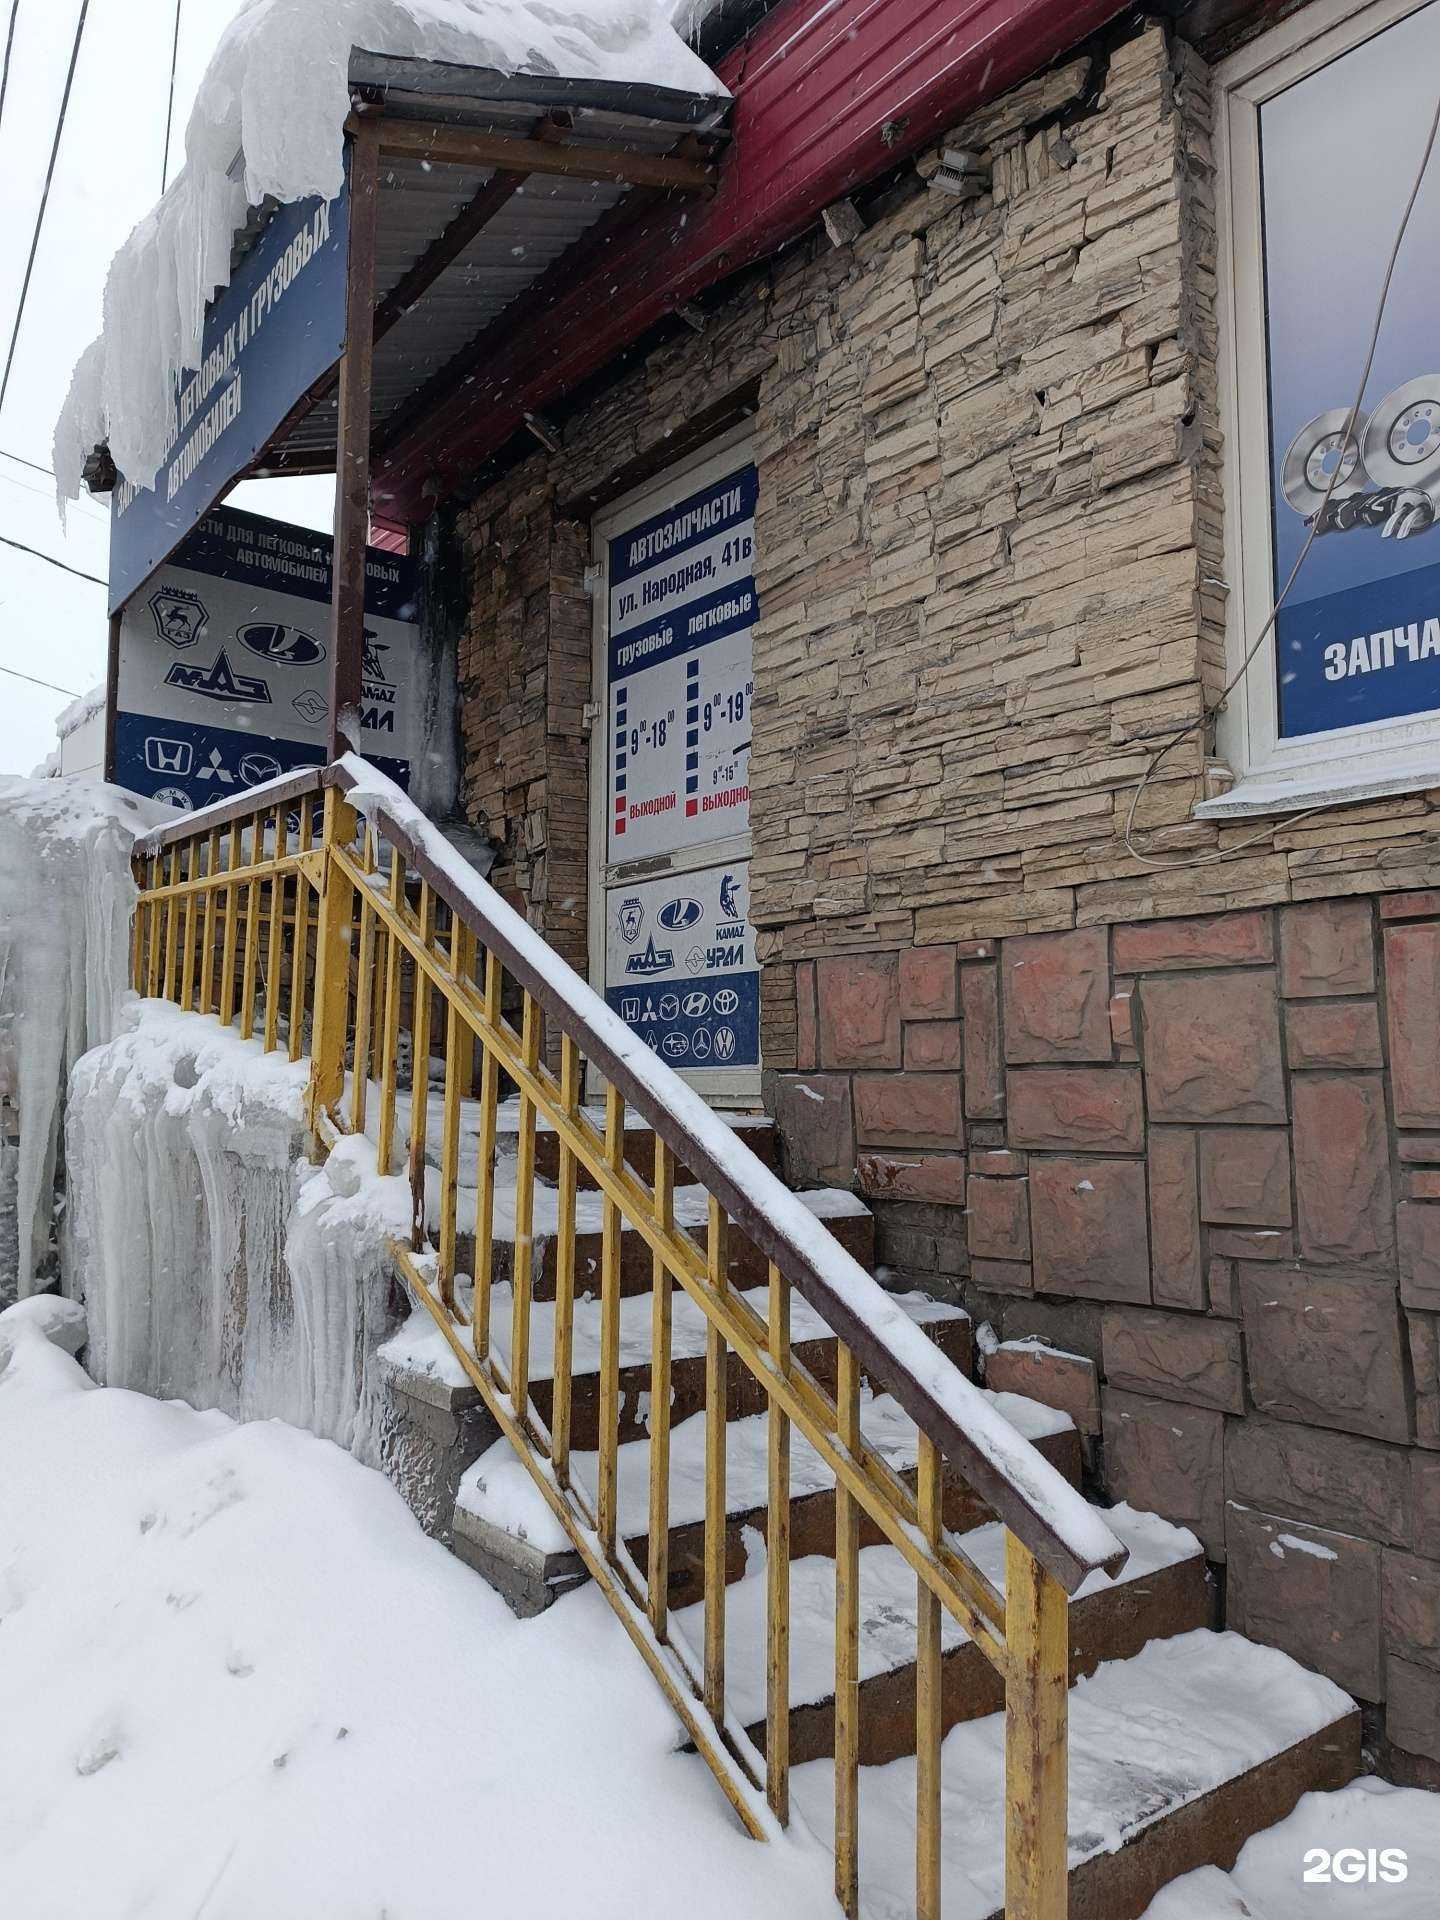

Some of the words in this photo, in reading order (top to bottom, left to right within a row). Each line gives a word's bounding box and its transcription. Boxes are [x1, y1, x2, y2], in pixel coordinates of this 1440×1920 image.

[239, 305, 248, 352] И
[251, 200, 330, 337] ГРУЗОВЫХ
[167, 365, 242, 503] АВТОМОБИЛЕЙ
[226, 524, 254, 546] ДЛЯ
[258, 533, 323, 564] ЛЕГКОВЫХ
[629, 486, 741, 568] АВТОЗАПЧАСТИ
[236, 548, 328, 584] АВТОМОБИЛЕЙ
[642, 555, 717, 606] Народная,
[688, 593, 752, 636] легковые
[617, 627, 673, 667] грузовые
[1324, 617, 1440, 681] ЗАПЧА
[630, 791, 676, 819] ВЫХОДНОЙ
[716, 925, 745, 941] KAMAZ
